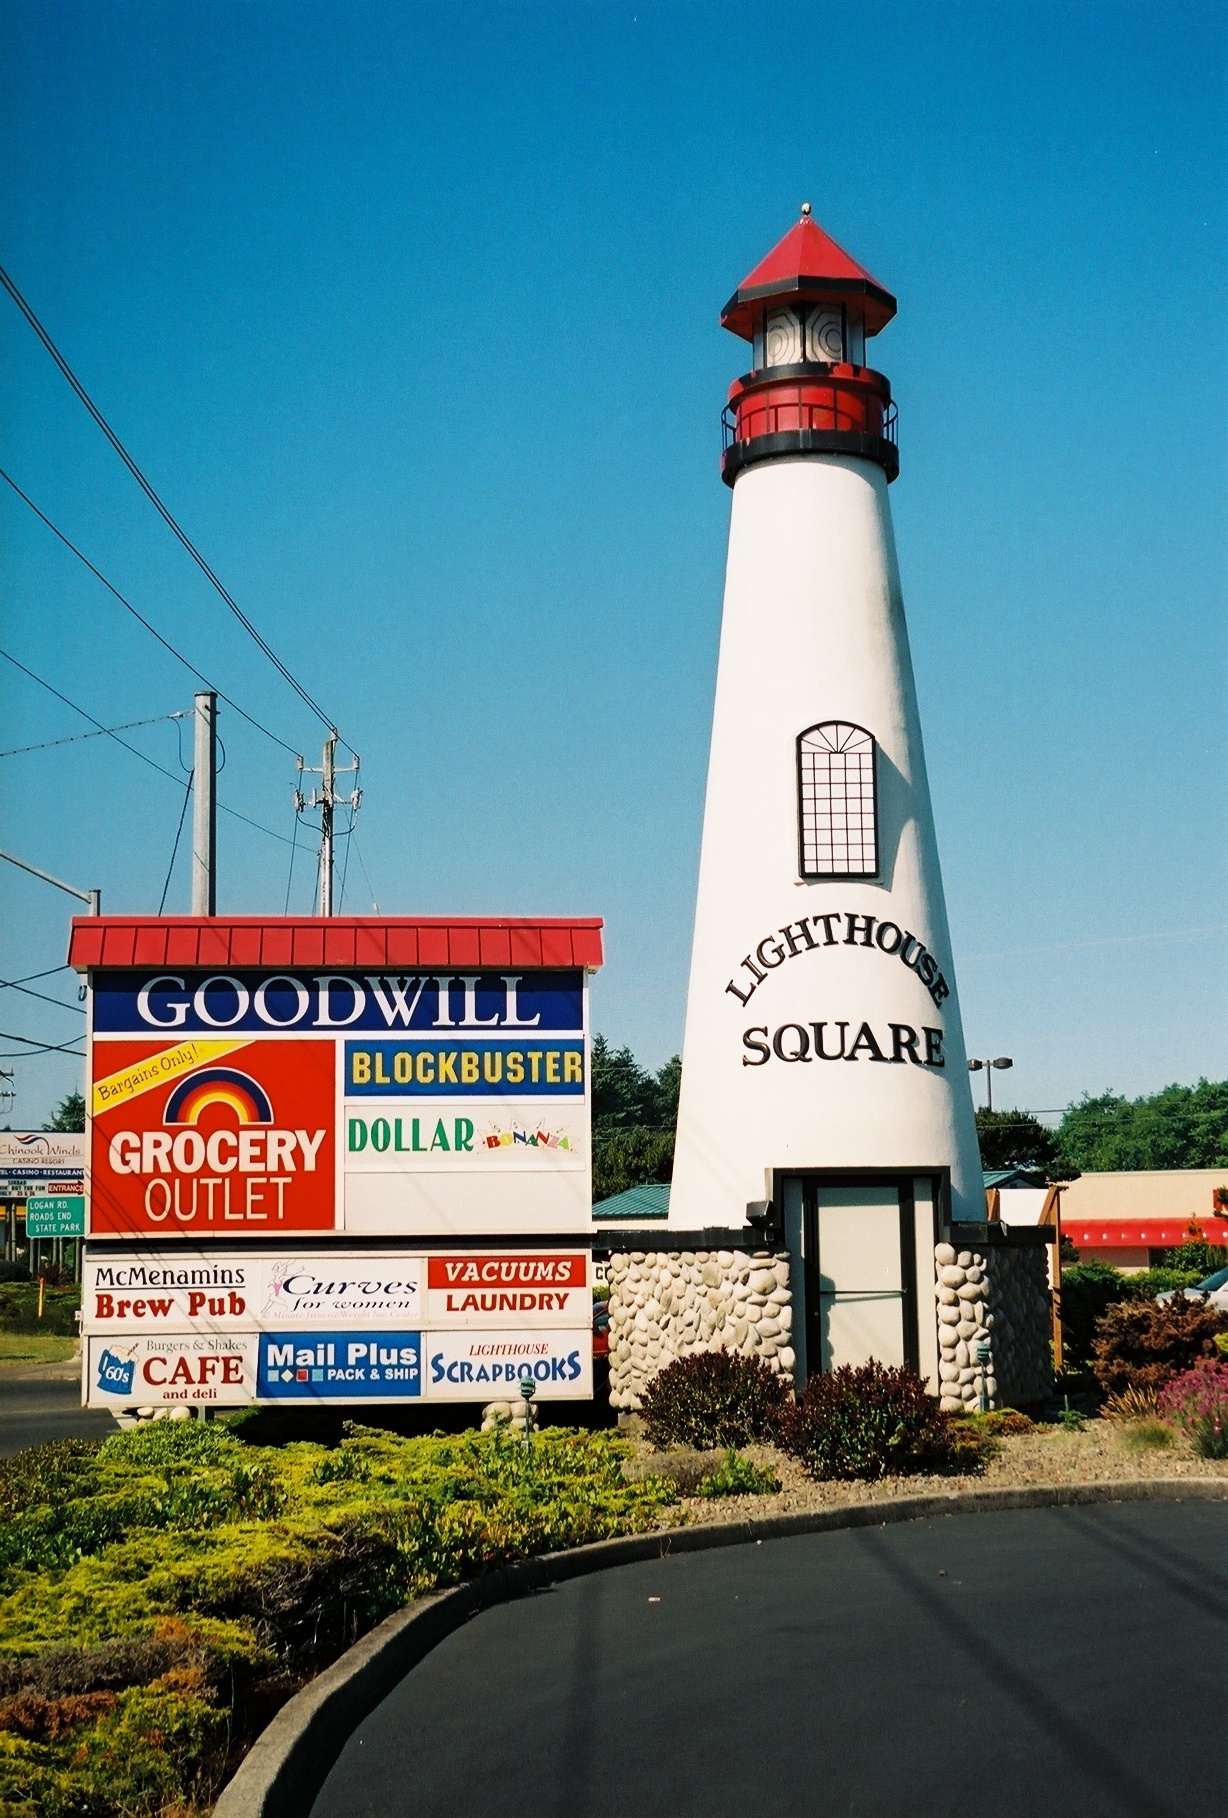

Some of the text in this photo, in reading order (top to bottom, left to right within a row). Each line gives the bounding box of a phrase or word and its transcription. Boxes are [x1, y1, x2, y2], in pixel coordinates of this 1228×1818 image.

[725, 913, 949, 1008] LIGHTHOUSE
[137, 976, 541, 1028] GOODWILL
[742, 1021, 945, 1068] SQUARE
[98, 1043, 199, 1101] Bargains Only!
[352, 1051, 582, 1084] BLOCKBUSTER
[348, 1117, 570, 1153] DOLLAR BONANZA
[47, 1145, 81, 1155] Winds
[108, 1129, 327, 1175] GROCERY
[48, 1184, 84, 1192] ENTRANCE
[29, 1201, 54, 1210] LOGAN
[144, 1177, 292, 1222] OUTLET
[29, 1211, 72, 1221] ROADS END
[35, 1222, 80, 1232] STATE PARK
[95, 1264, 245, 1286] McMenamins
[445, 1260, 572, 1282] VACUUMS
[282, 1274, 418, 1296] Curves
[95, 1291, 246, 1319] Brew Pub
[291, 1297, 411, 1312] for women
[446, 1292, 570, 1312] LAUNDRY
[146, 1339, 248, 1353] Burgers & Shakes
[267, 1342, 418, 1367] Mail Plus
[468, 1343, 549, 1356] LIGHTHOUSE
[142, 1355, 244, 1386] CAFE
[327, 1368, 419, 1380] PACK & SHIP
[430, 1350, 581, 1383] SCRAPBOOKS
[162, 1388, 217, 1400] and deli
